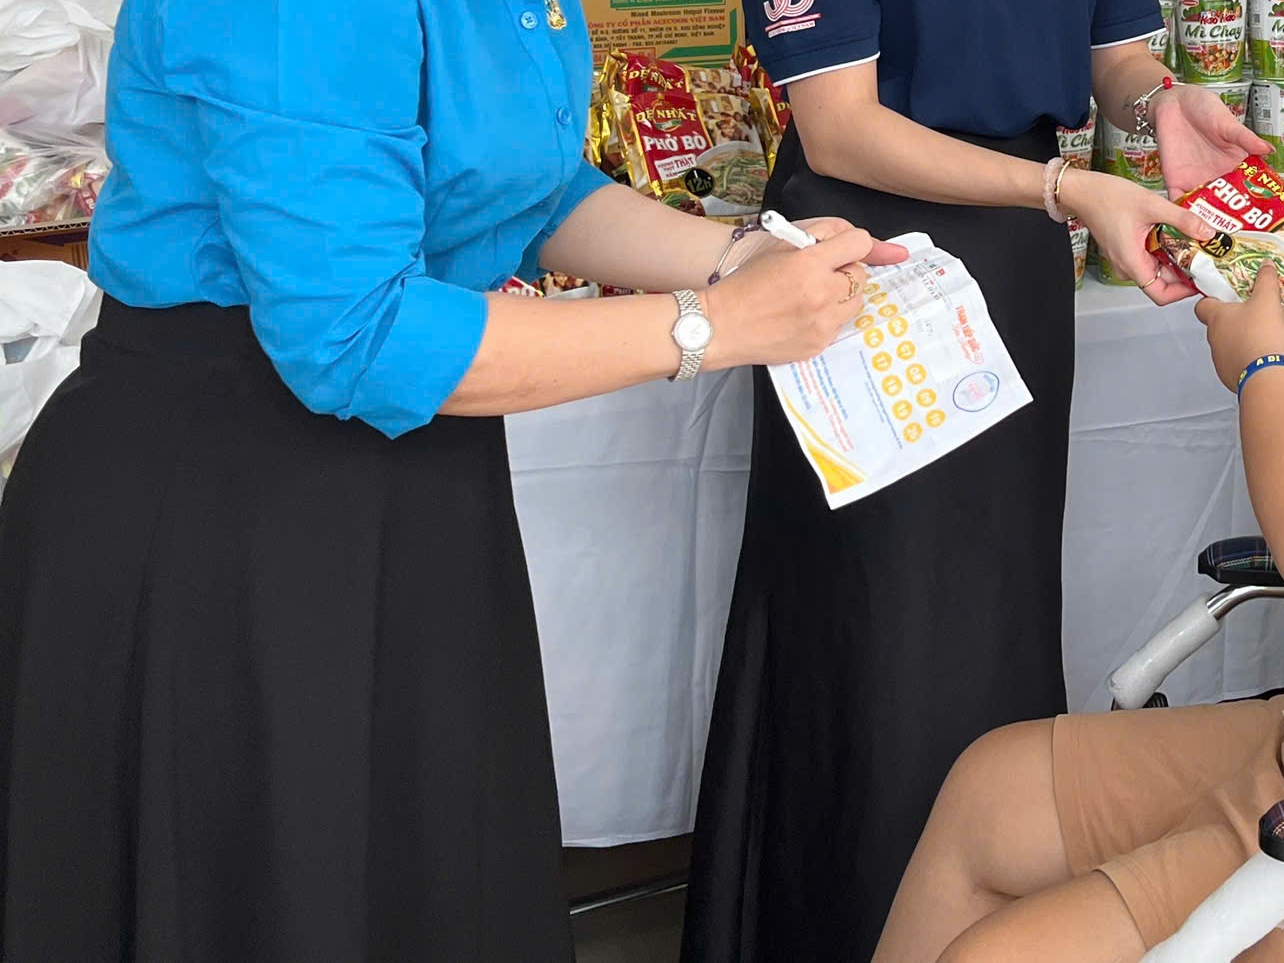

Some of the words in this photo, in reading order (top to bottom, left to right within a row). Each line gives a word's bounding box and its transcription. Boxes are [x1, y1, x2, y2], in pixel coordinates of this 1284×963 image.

[1185, 24, 1205, 39] Mì
[1208, 23, 1243, 40] Chay
[644, 133, 678, 152] PHỞ
[680, 131, 707, 150] BÒ
[1207, 178, 1250, 211] PHỞ
[1242, 208, 1274, 229] BÒ
